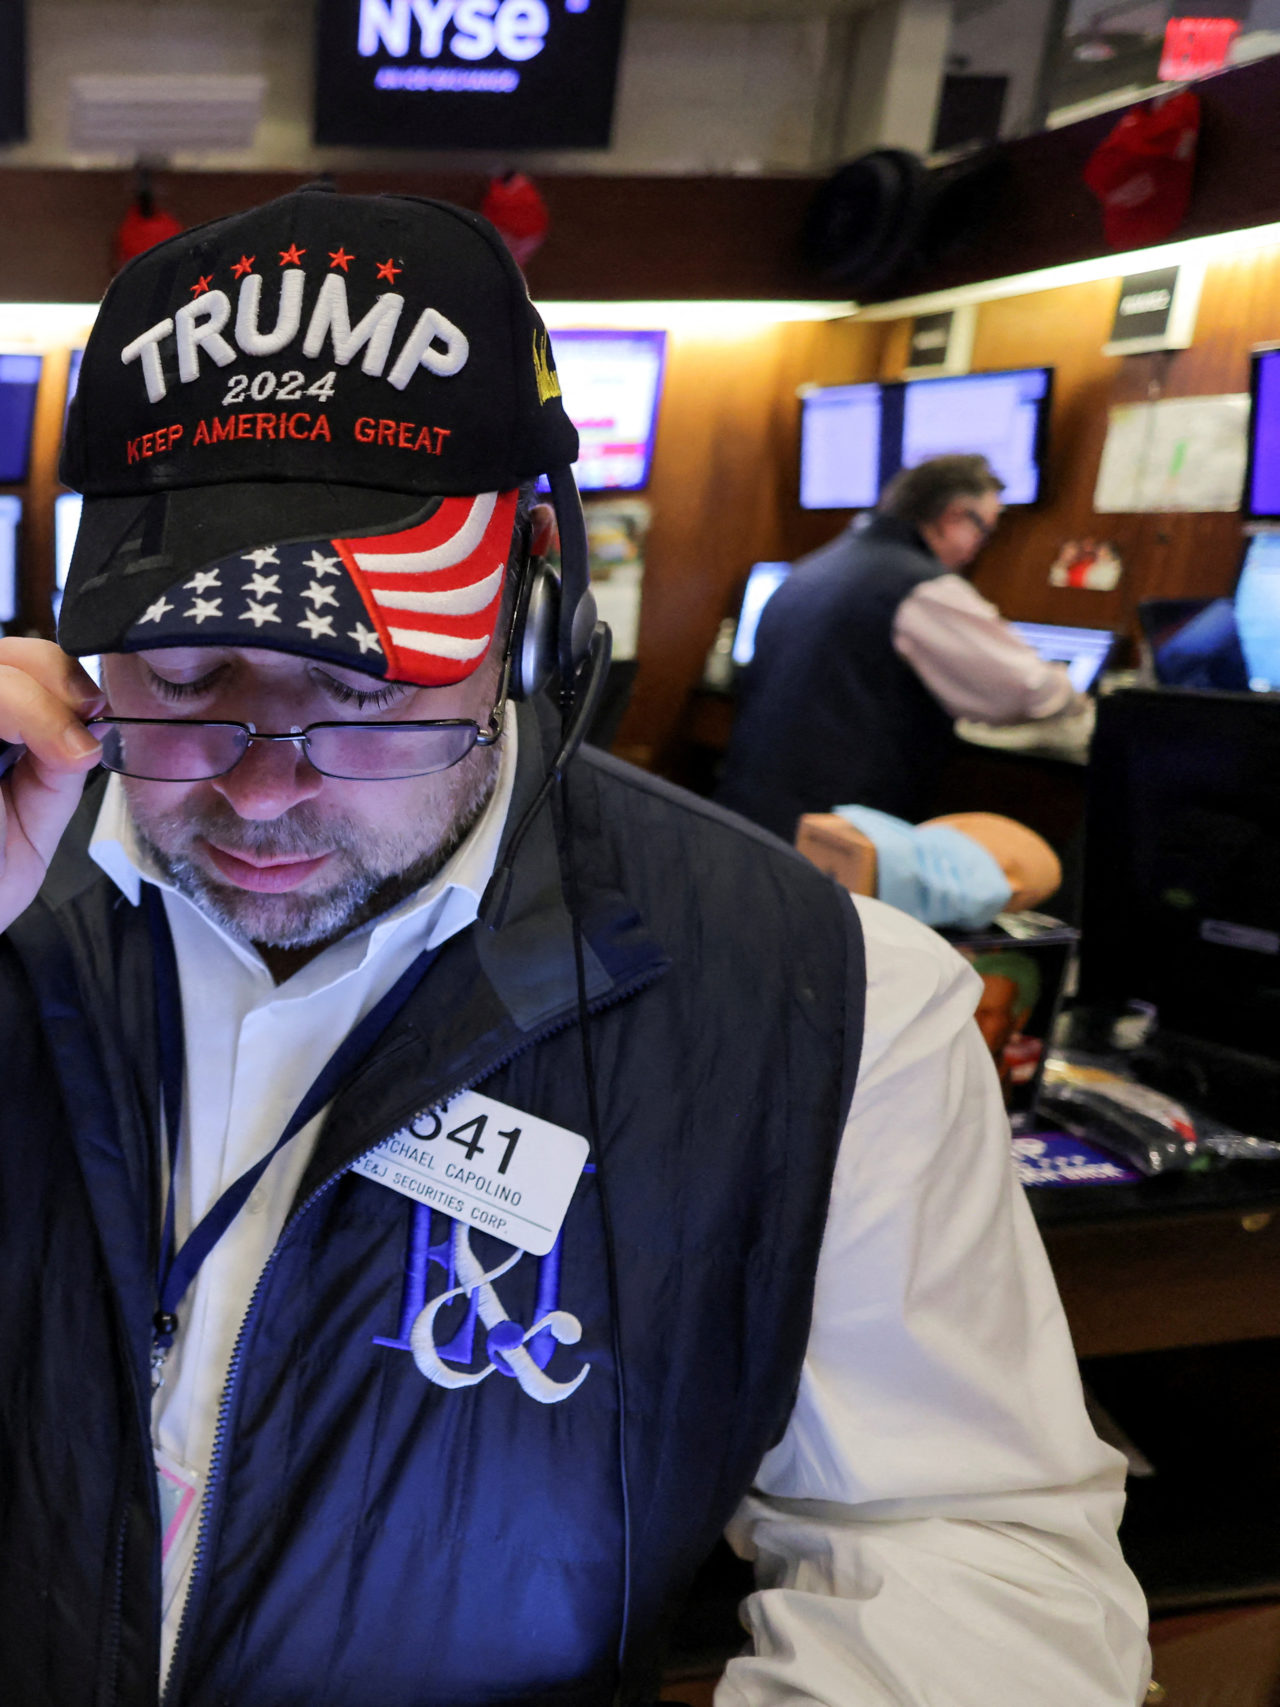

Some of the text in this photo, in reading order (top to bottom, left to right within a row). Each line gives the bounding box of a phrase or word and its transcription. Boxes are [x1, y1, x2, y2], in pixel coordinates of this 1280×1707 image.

[121, 268, 469, 403] TRUMP
[222, 370, 336, 406] 2024
[126, 412, 451, 465] KEEP AMERICA GREAT
[381, 1138, 522, 1207] ICHAEL CAPOLINO
[392, 1172, 464, 1213] SECURITIES
